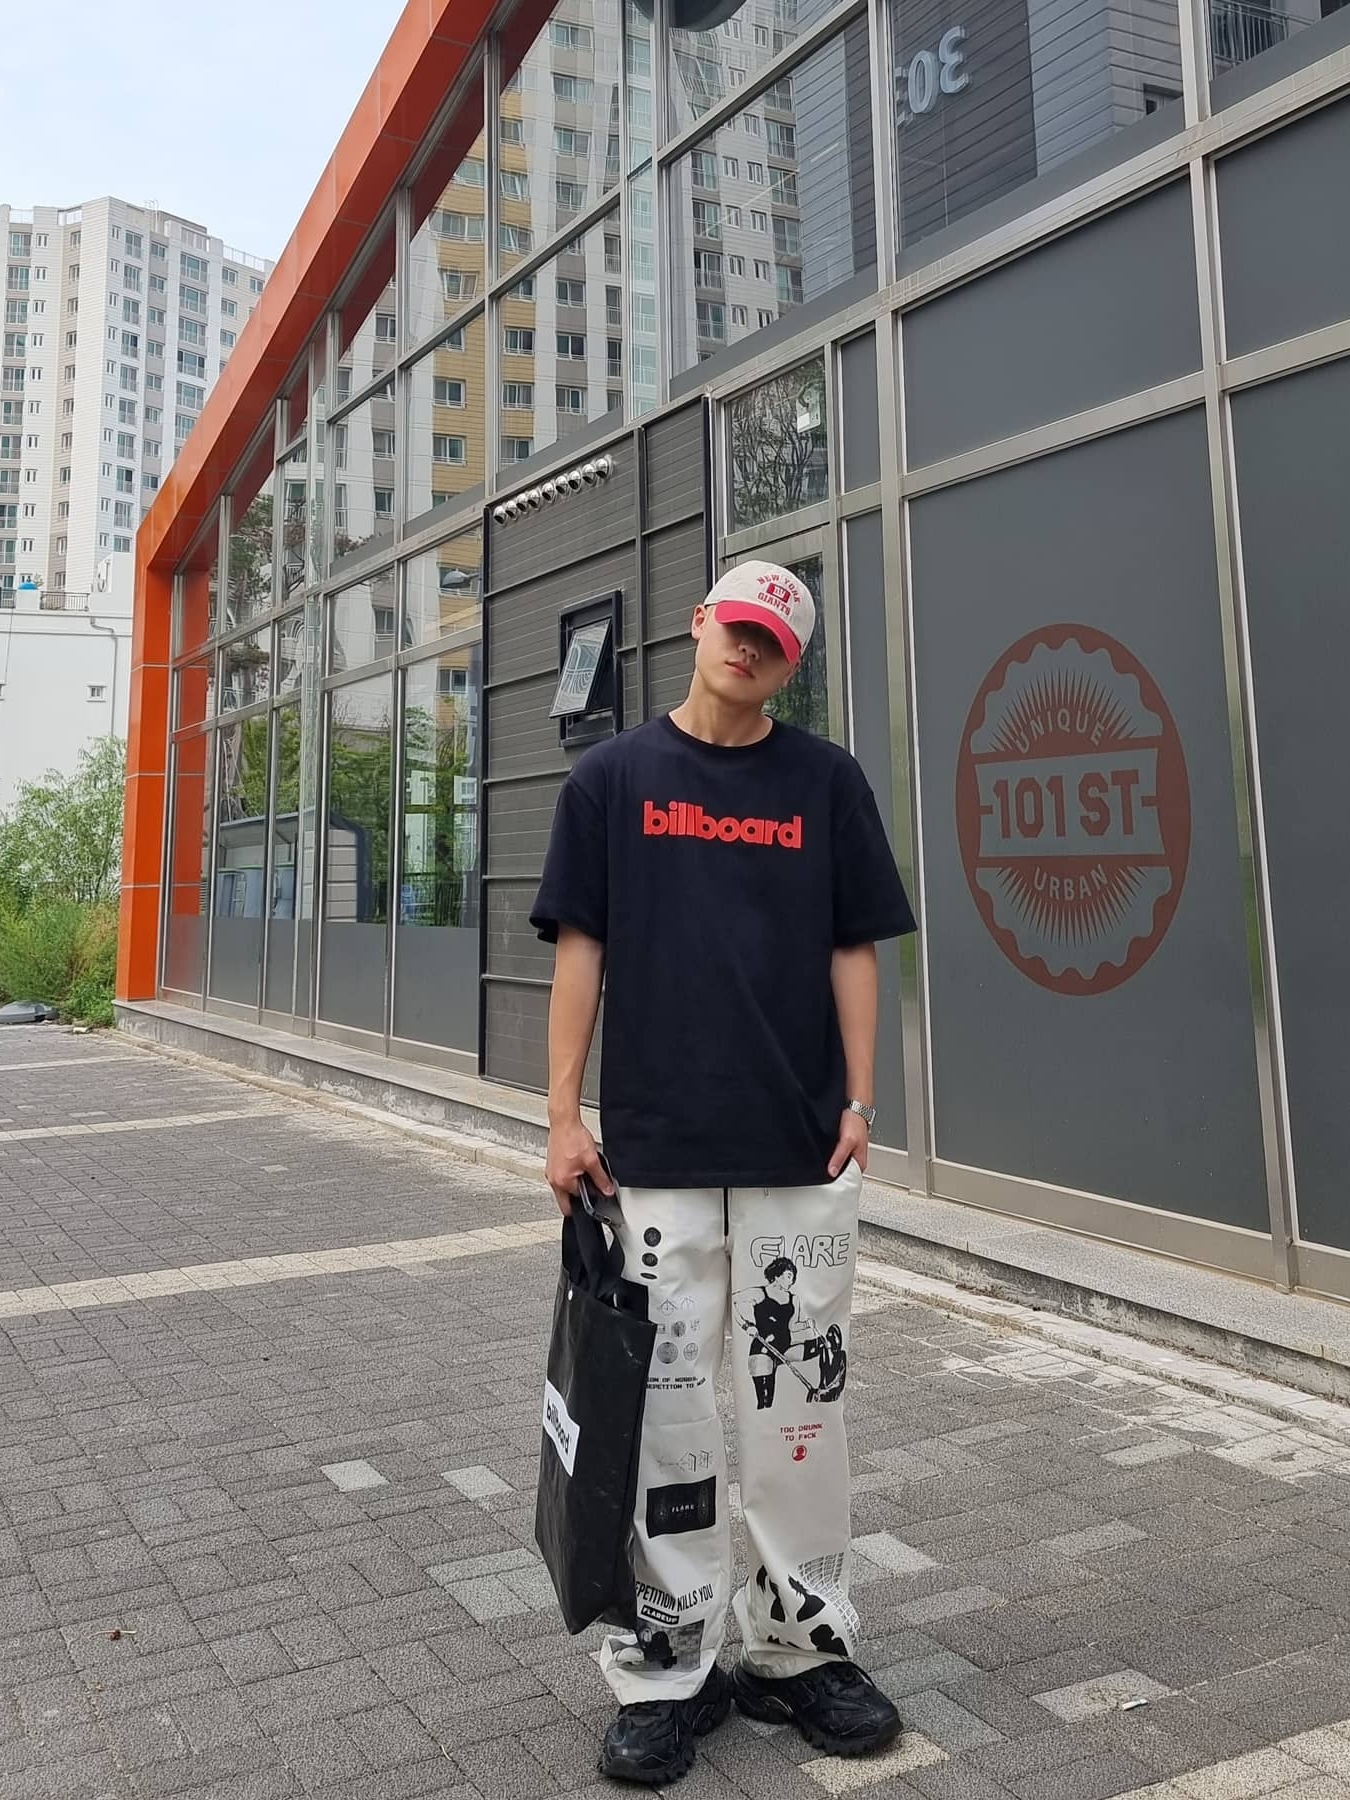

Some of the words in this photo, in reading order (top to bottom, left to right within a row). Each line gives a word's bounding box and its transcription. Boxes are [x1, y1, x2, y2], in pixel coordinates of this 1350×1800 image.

[757, 574, 779, 584] NEW
[784, 577, 800, 603] YORK
[757, 592, 791, 616] GIANTS
[1015, 707, 1105, 753] UNIQUE
[643, 800, 802, 849] billboard
[1033, 863, 1109, 901] URBAN
[798, 1424, 823, 1432] DRUNK
[677, 1590, 698, 1612] KILLS
[698, 1583, 714, 1603] YOU
